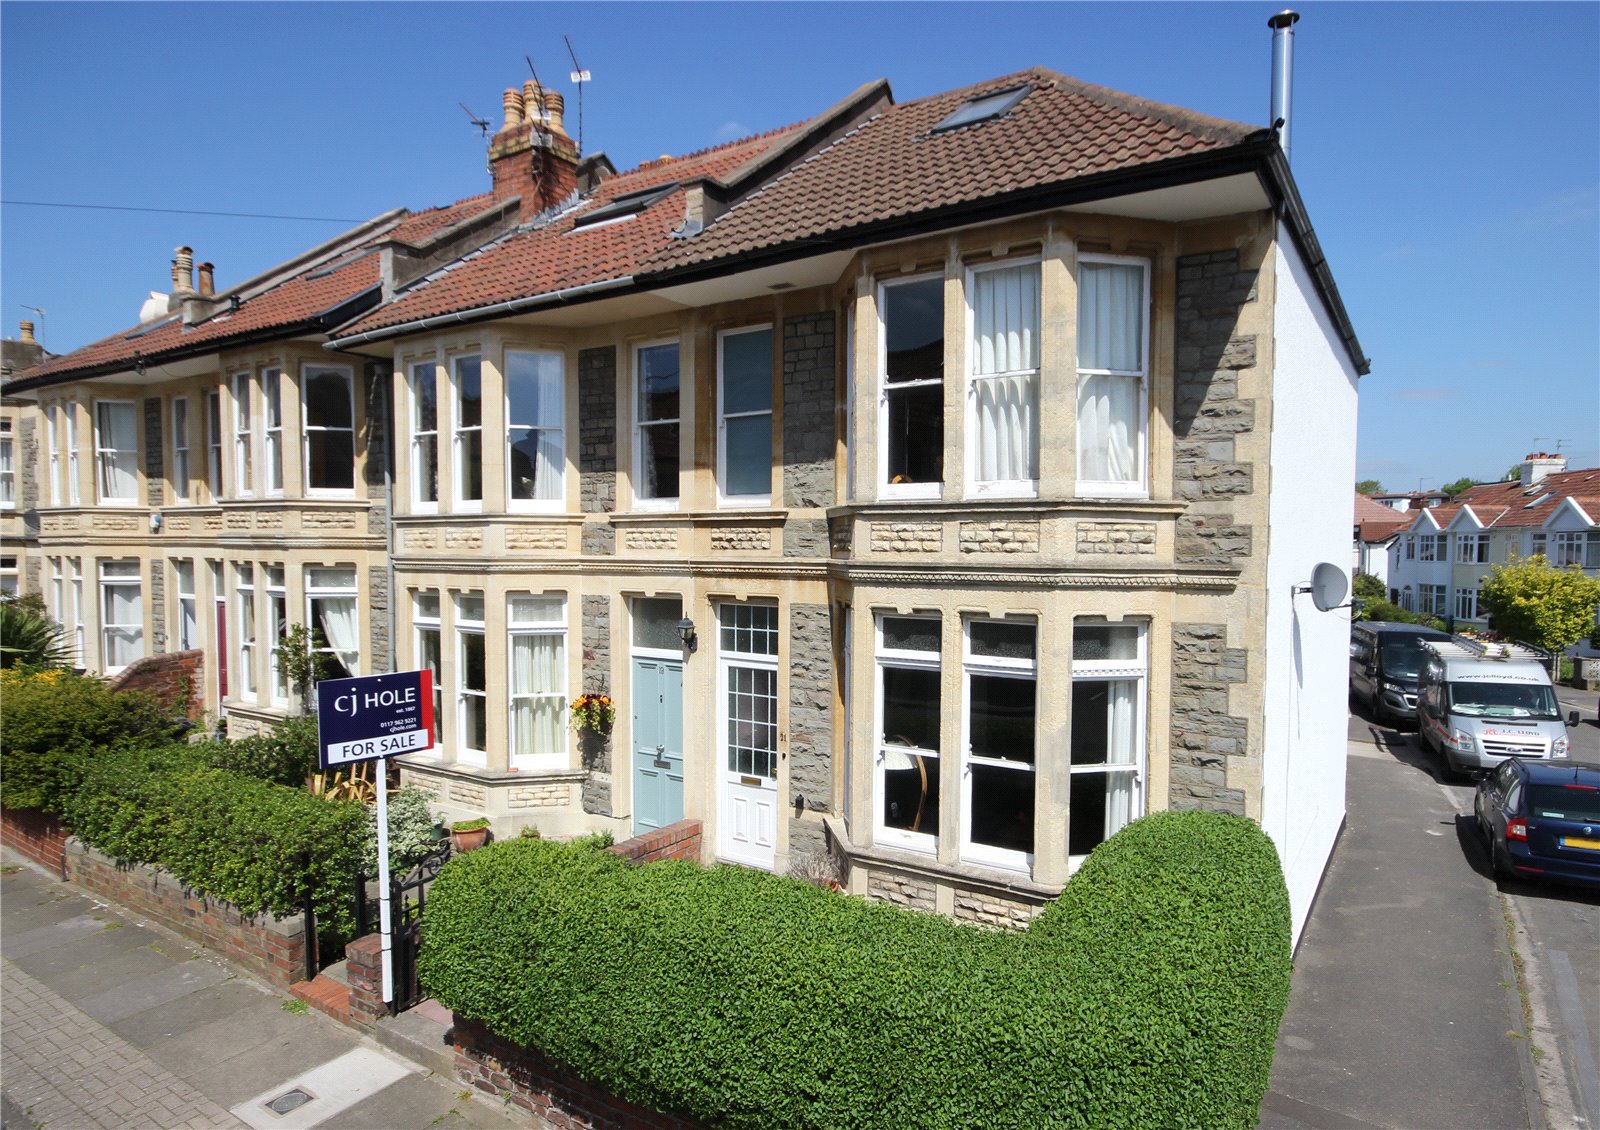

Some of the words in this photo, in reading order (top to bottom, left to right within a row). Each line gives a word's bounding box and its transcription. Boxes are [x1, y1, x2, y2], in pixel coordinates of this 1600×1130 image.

[364, 688, 416, 708] HOLE
[390, 724, 416, 732] cjhole.com
[343, 742, 374, 758] FOR
[380, 734, 416, 752] SALE
